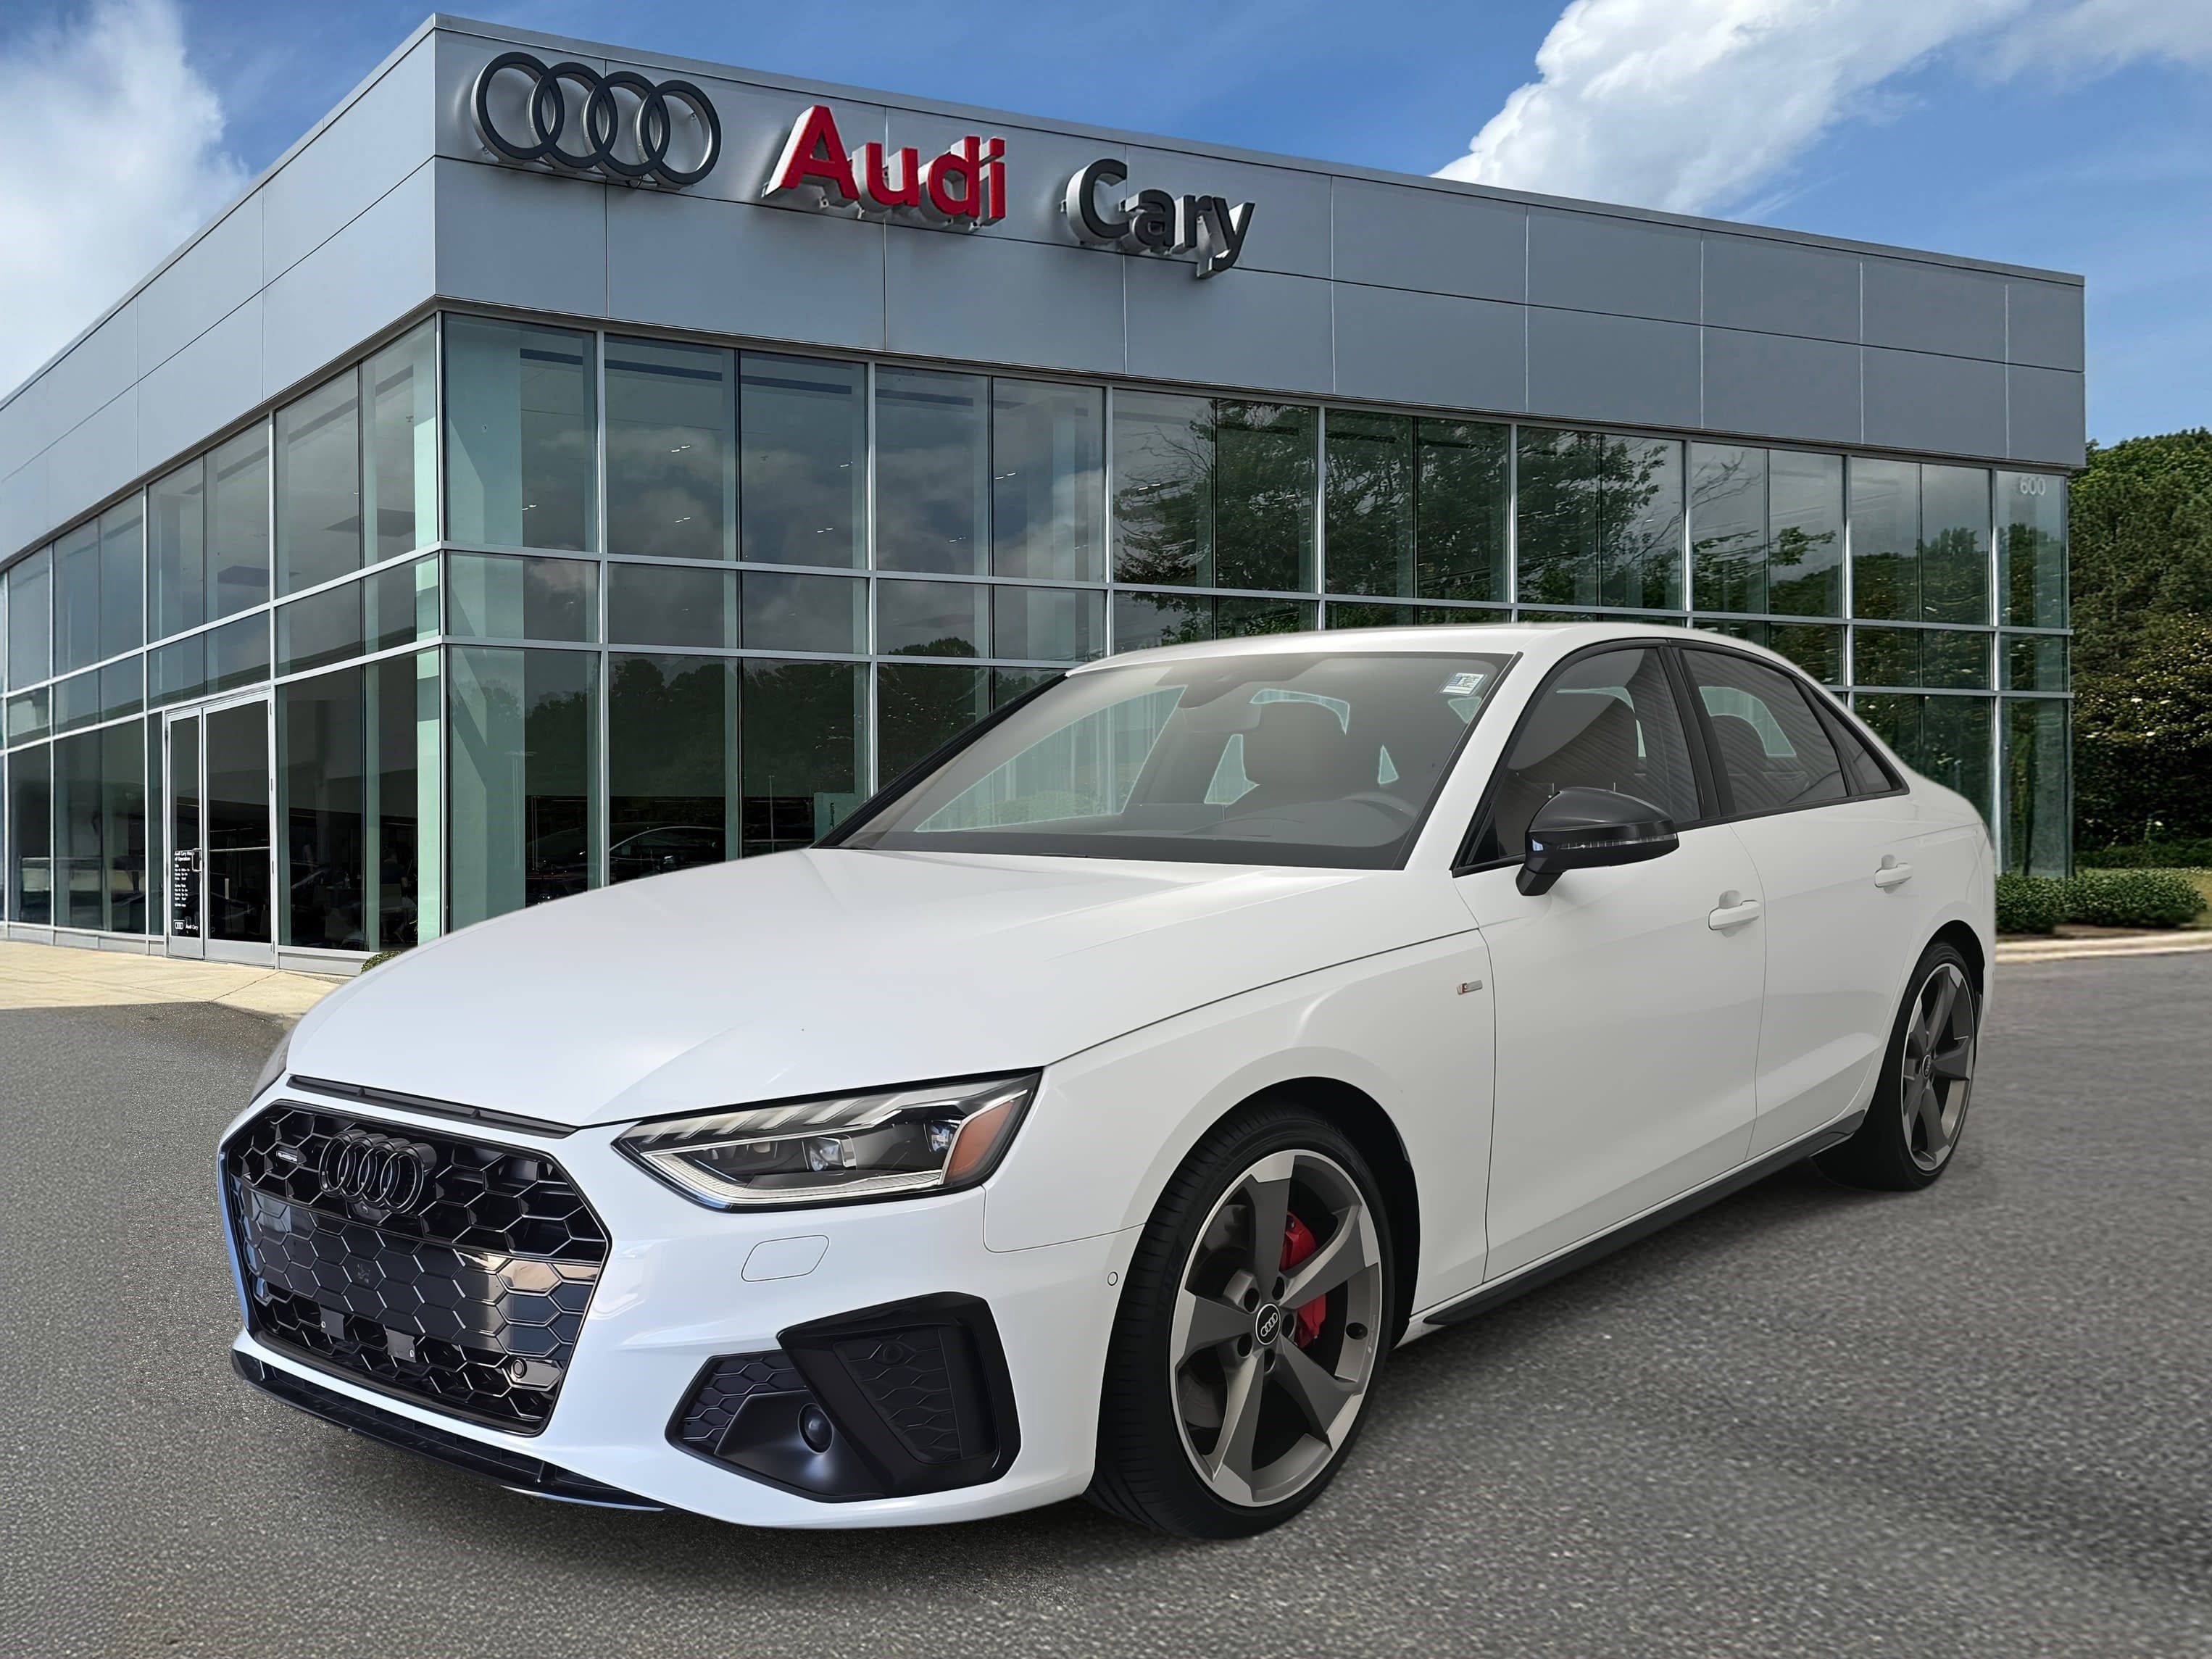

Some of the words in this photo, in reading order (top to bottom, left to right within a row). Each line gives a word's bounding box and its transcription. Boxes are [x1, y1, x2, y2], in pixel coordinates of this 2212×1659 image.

[767, 104, 1006, 220] Audi
[1068, 158, 1255, 274] Cary
[2019, 475, 2045, 496] 600
